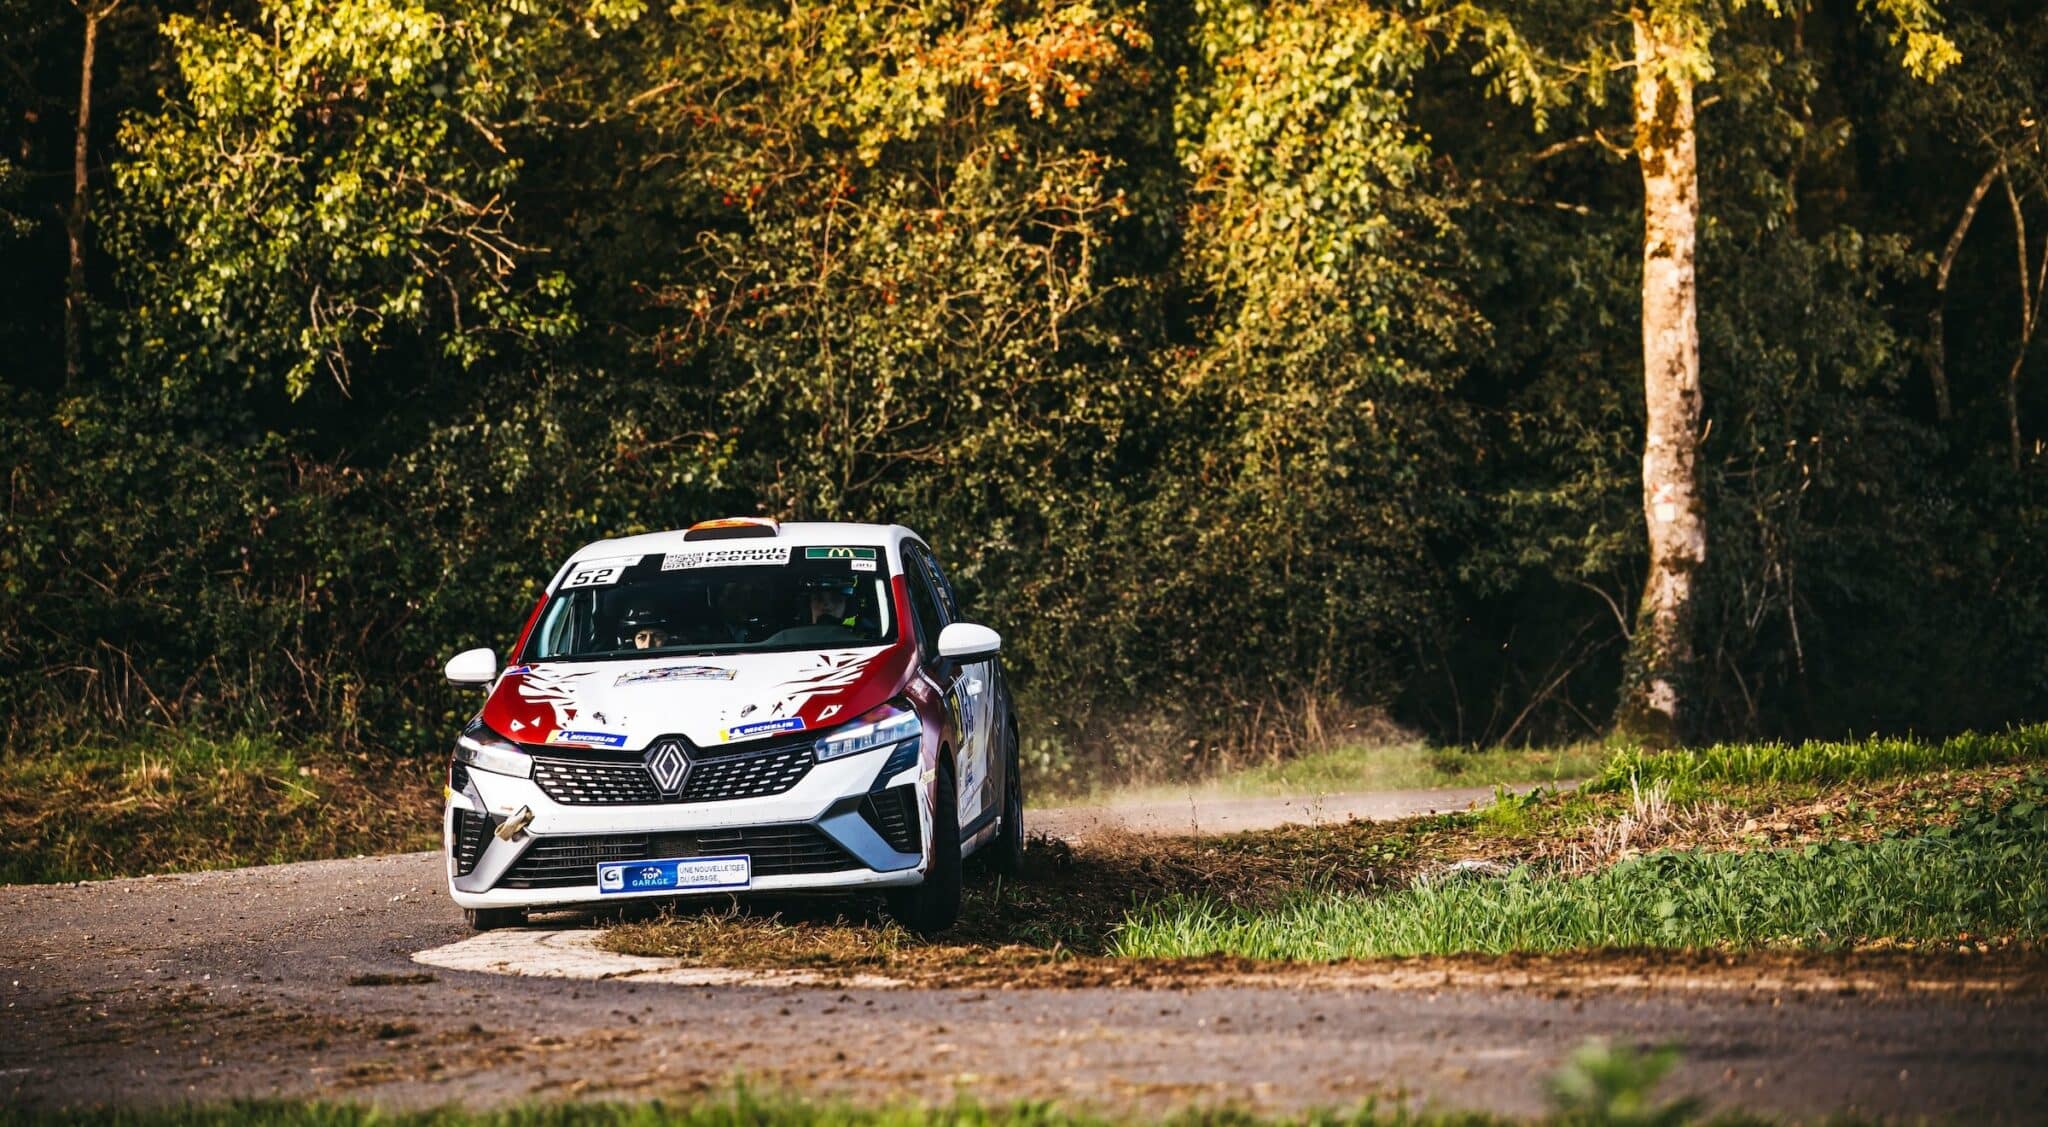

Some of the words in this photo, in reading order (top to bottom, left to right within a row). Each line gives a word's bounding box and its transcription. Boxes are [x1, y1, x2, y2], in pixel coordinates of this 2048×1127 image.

[707, 548, 787, 557] renault
[572, 568, 614, 585] 52
[743, 722, 794, 734] MICHELIN
[568, 734, 618, 743] MICHELIN
[694, 863, 728, 873] NOUVELLE
[632, 878, 668, 887] GARAGE
